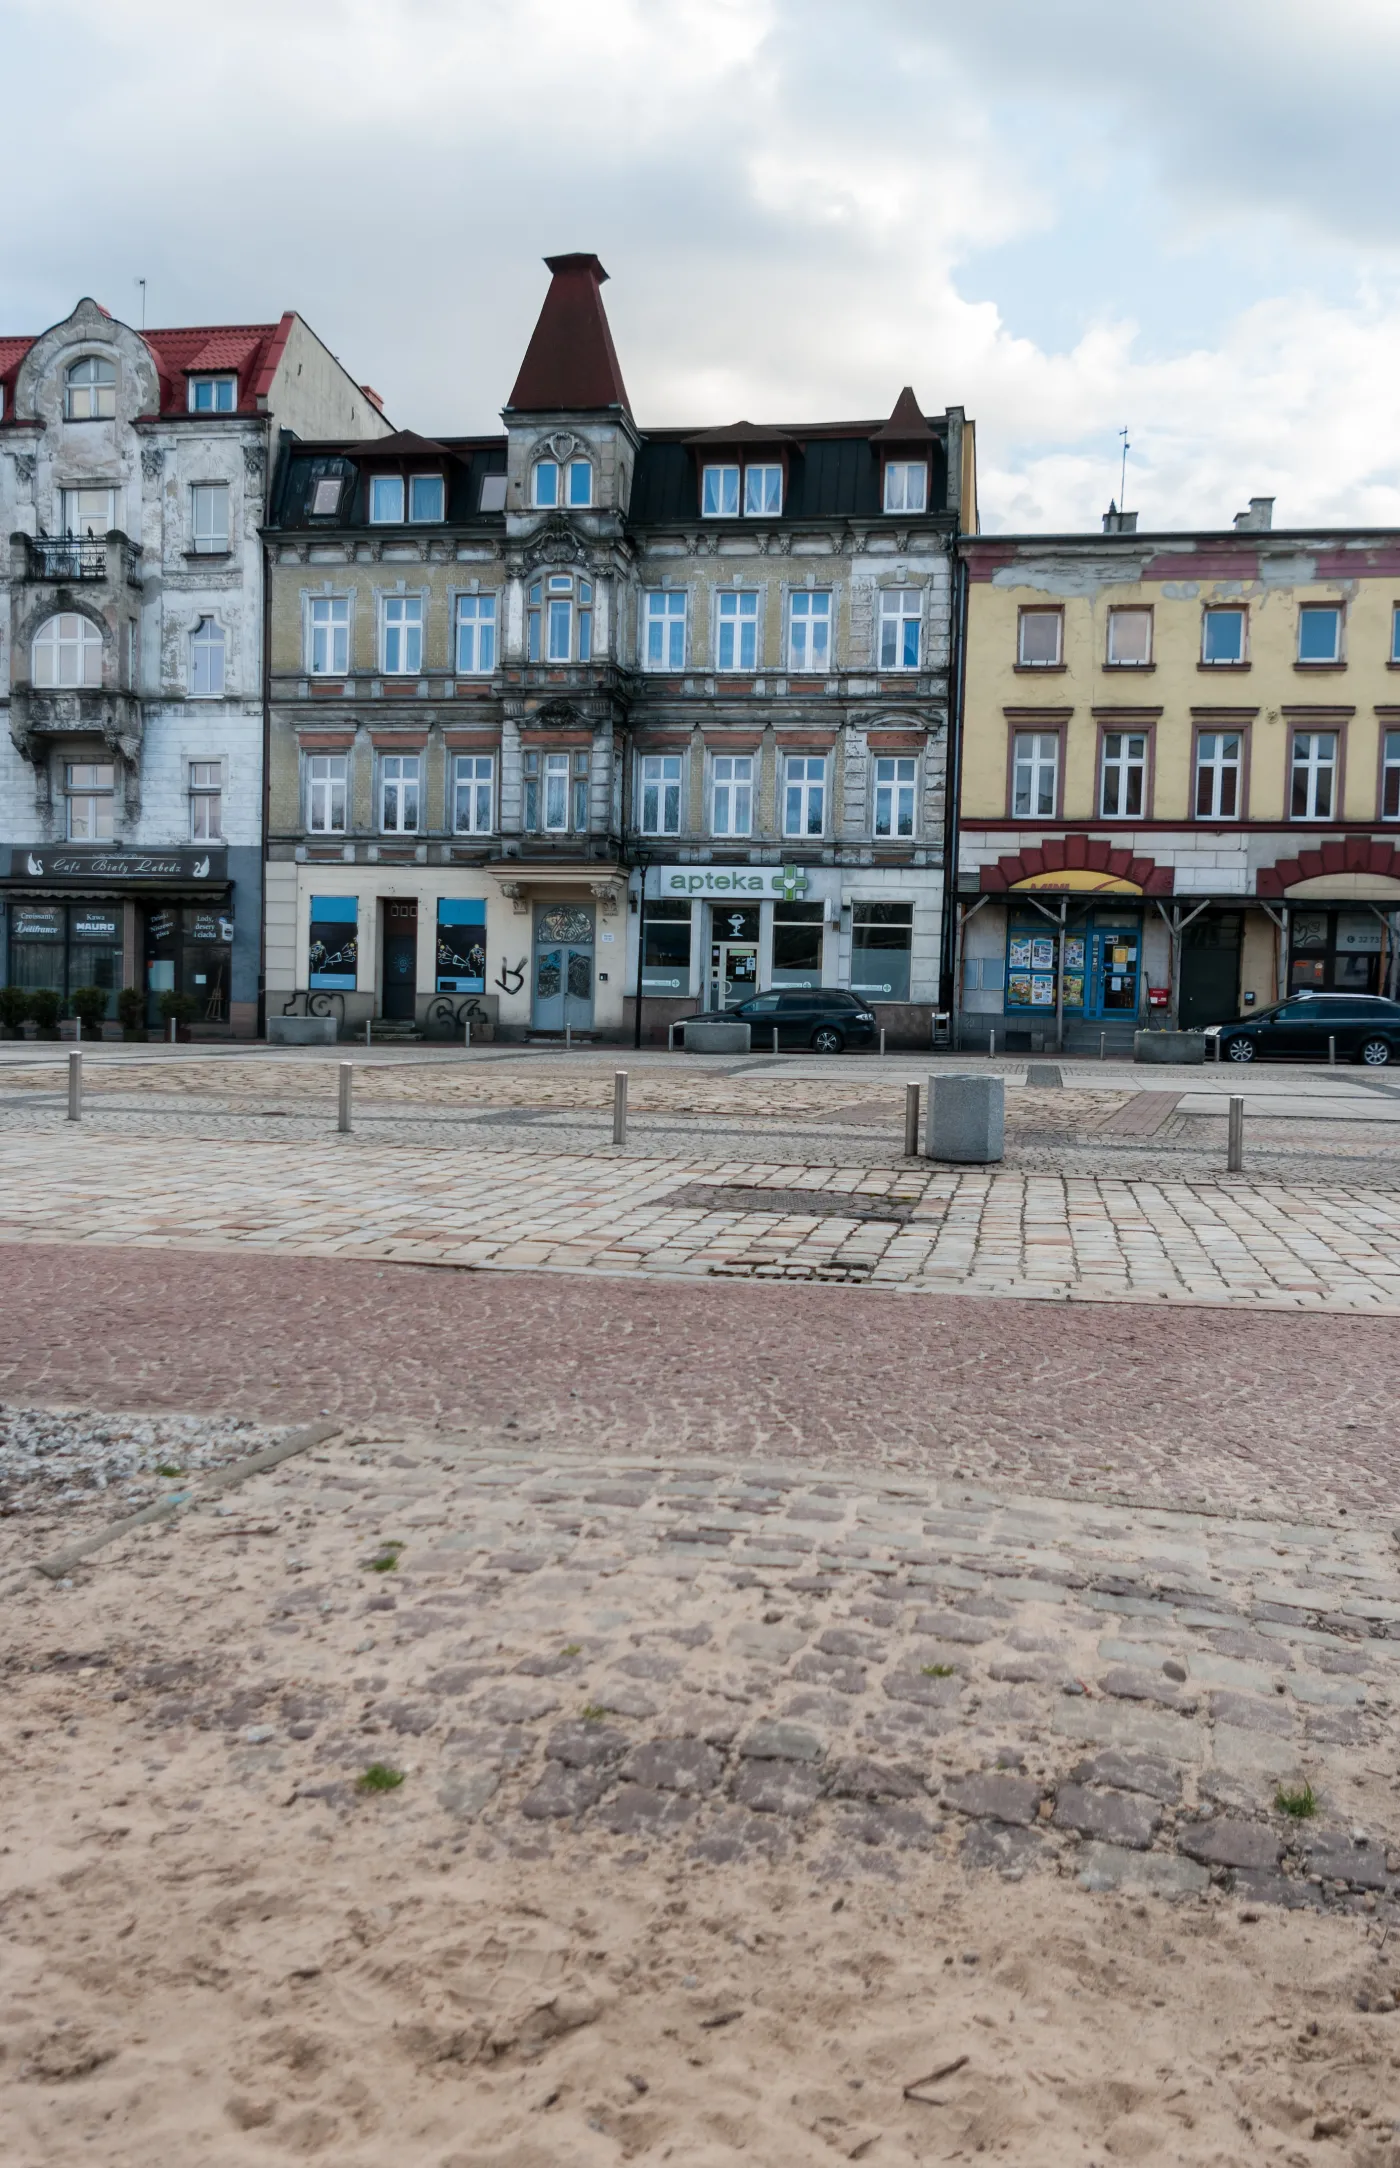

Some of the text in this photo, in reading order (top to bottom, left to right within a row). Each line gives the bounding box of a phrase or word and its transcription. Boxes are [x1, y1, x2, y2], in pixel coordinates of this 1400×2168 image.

[670, 872, 764, 893] apteka
[20, 912, 56, 922] Croissanty
[86, 913, 106, 921] Kawa
[76, 923, 116, 931] MAURO
[1358, 936, 1368, 944] 32
